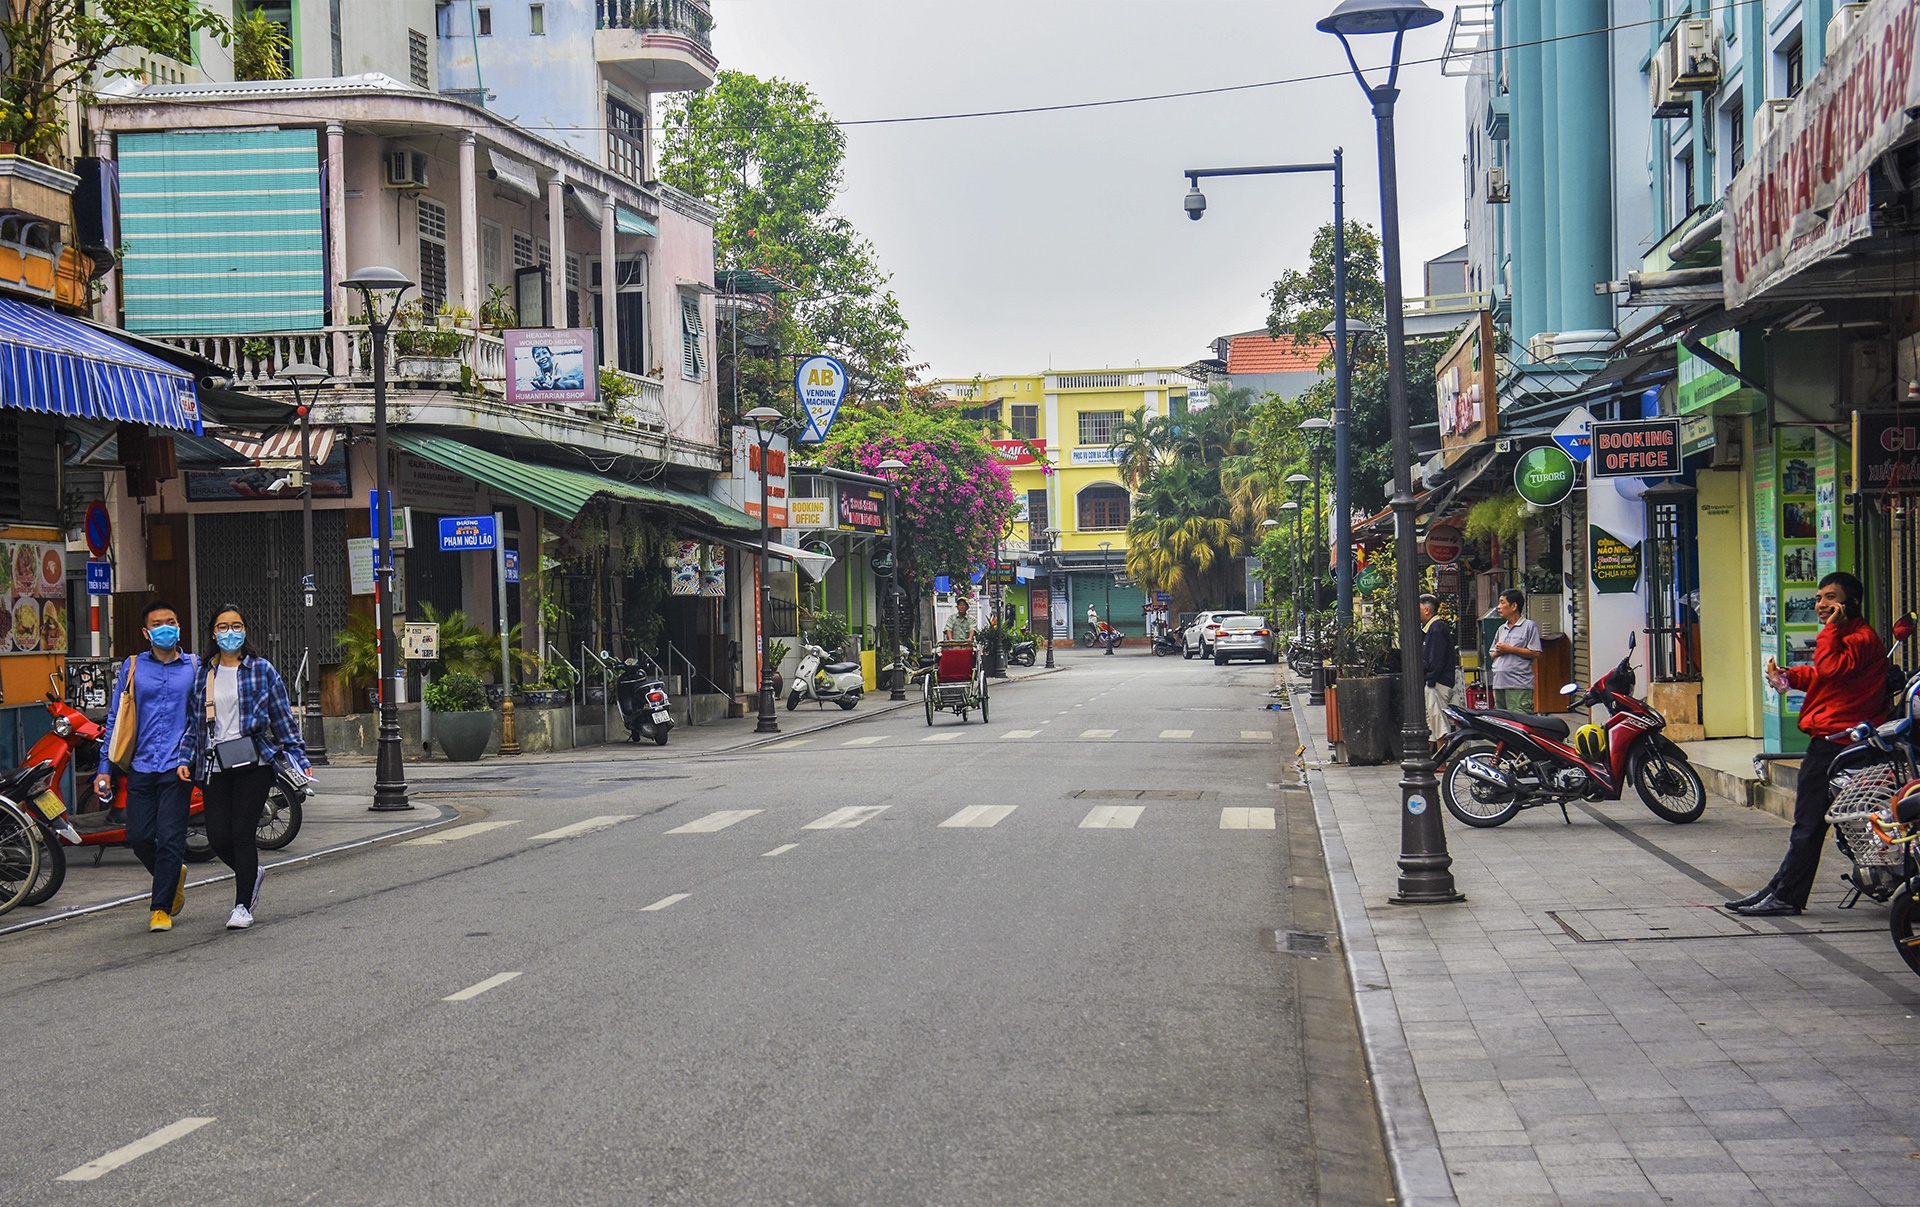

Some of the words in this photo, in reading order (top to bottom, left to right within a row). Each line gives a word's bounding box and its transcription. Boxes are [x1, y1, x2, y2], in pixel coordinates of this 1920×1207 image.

[807, 368, 834, 387] AB
[515, 392, 565, 400] HUMANITARIAN
[566, 391, 585, 399] SHOP
[805, 389, 836, 398] VENDING
[805, 398, 837, 407] MACHINE
[816, 418, 828, 427] 24
[1569, 437, 1591, 447] ATM
[1599, 430, 1674, 449] BOOKING
[1606, 450, 1669, 469] OFFICE
[1530, 471, 1566, 484] TUBORG
[792, 501, 824, 513] BOOKING
[795, 513, 820, 525] OFFICE
[444, 537, 463, 547] PHẠM
[479, 533, 492, 545] LÃO
